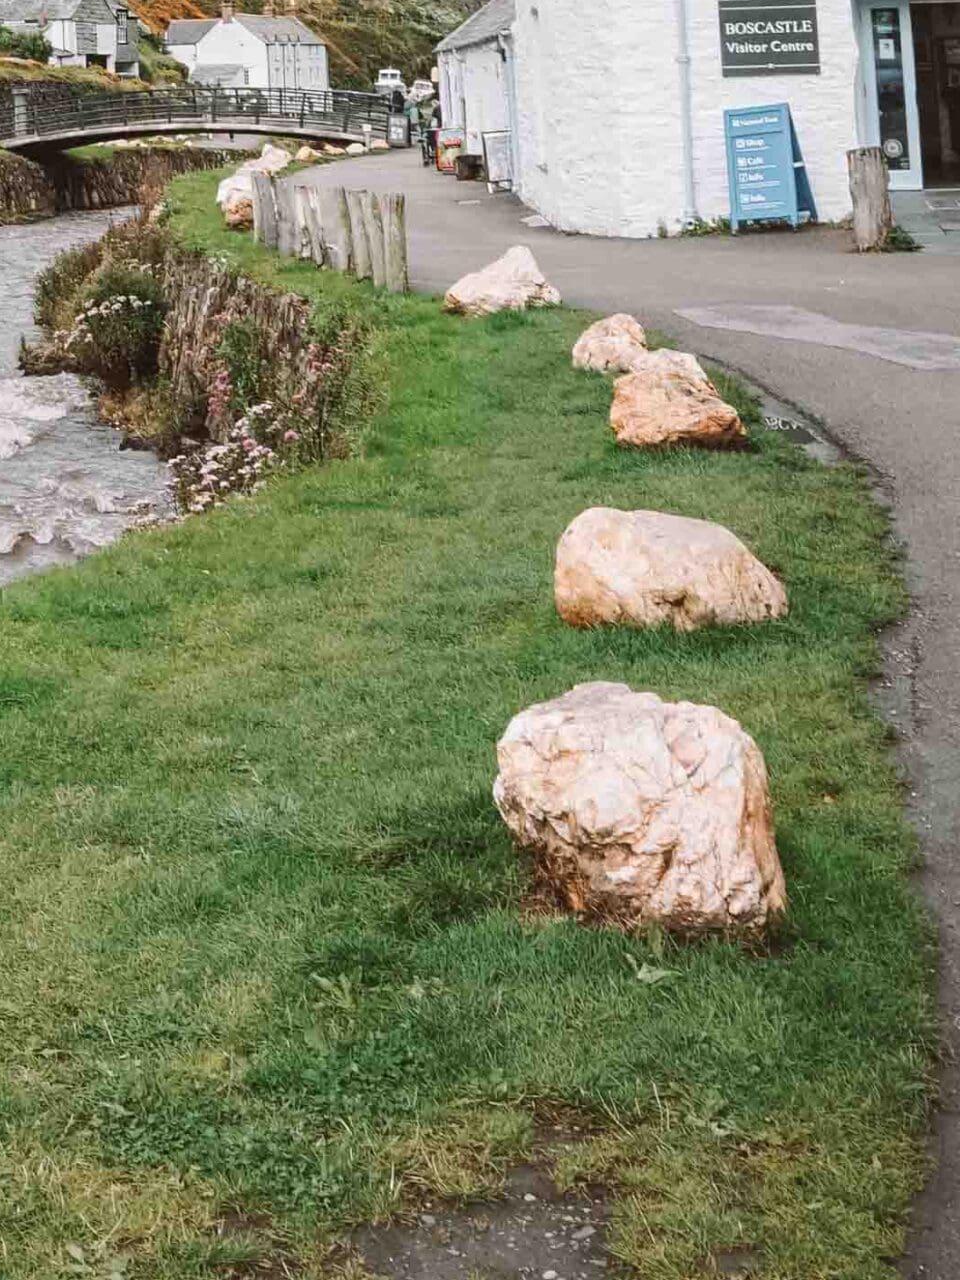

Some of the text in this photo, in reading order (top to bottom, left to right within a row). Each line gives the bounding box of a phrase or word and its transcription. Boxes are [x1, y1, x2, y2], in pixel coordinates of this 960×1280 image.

[725, 20, 813, 35] BOSCASTLE
[726, 40, 814, 53] Visitor Centre
